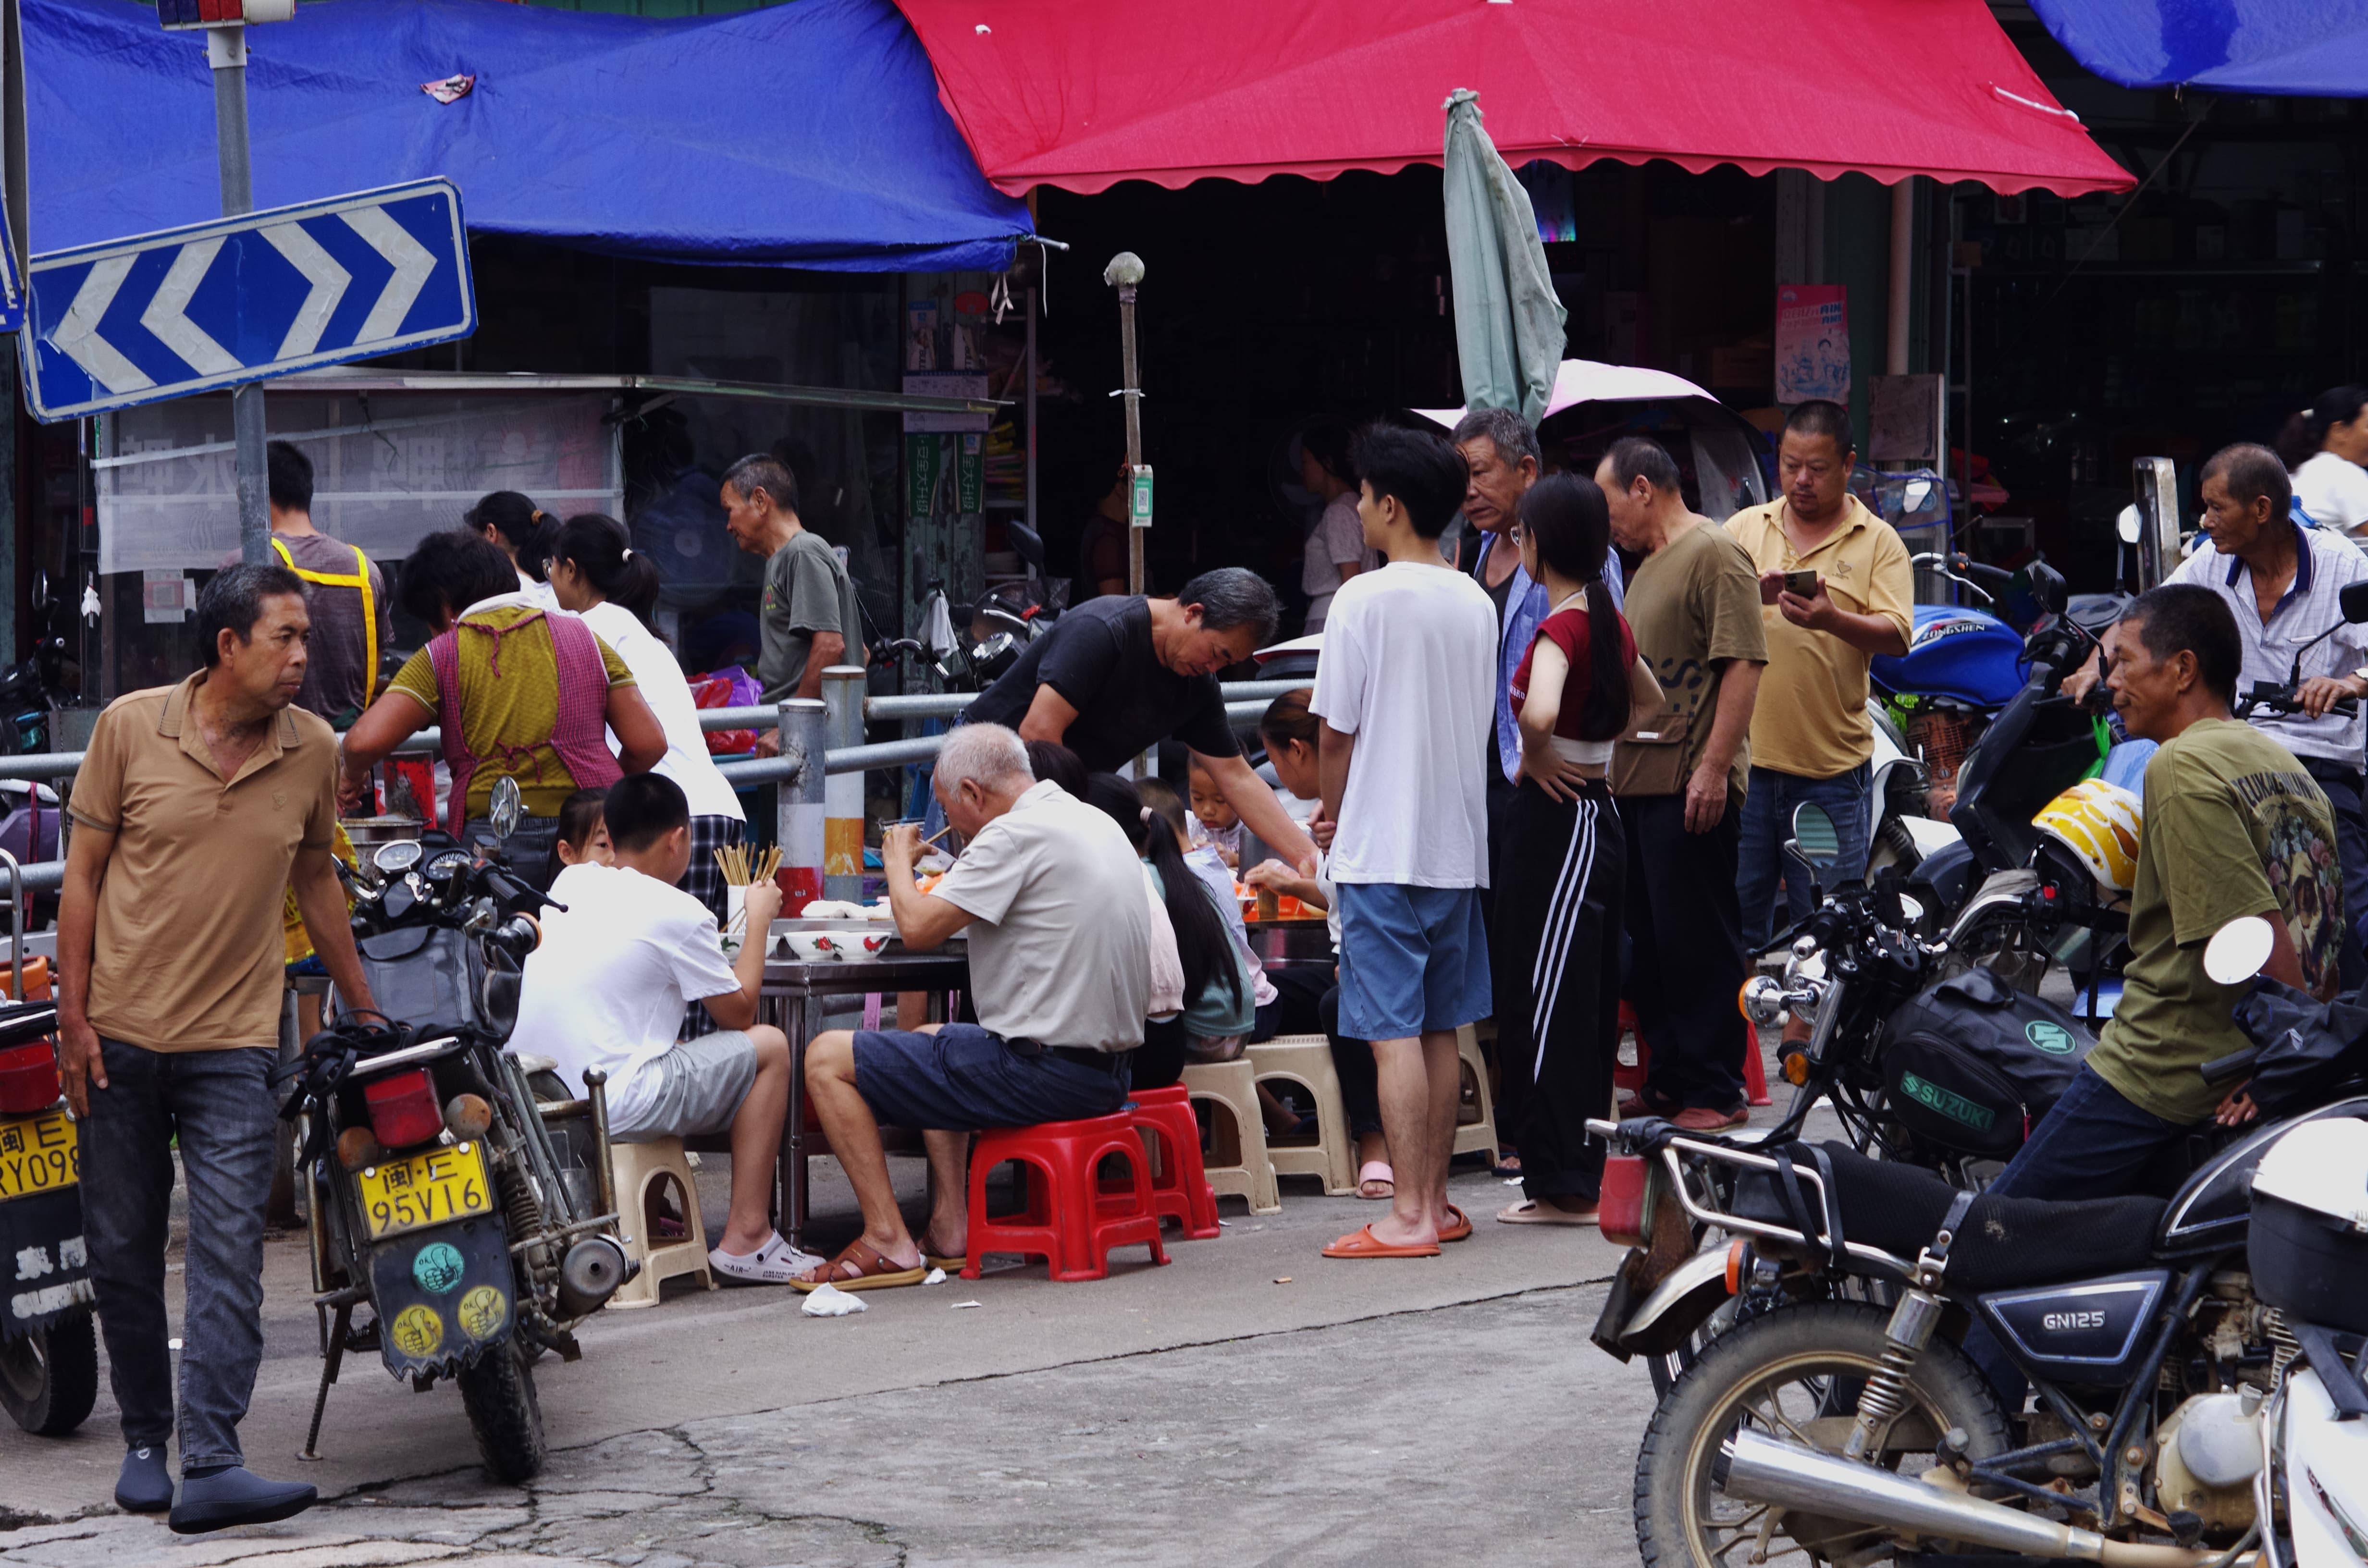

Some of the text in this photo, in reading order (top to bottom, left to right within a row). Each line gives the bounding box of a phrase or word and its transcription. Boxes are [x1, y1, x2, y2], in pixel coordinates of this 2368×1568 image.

[1922, 624, 1985, 640] ZONGSHEN
[1920, 1085, 1992, 1130] SUZUKI
[372, 1178, 481, 1233] 95V16
[2043, 1311, 2105, 1330] GN125
